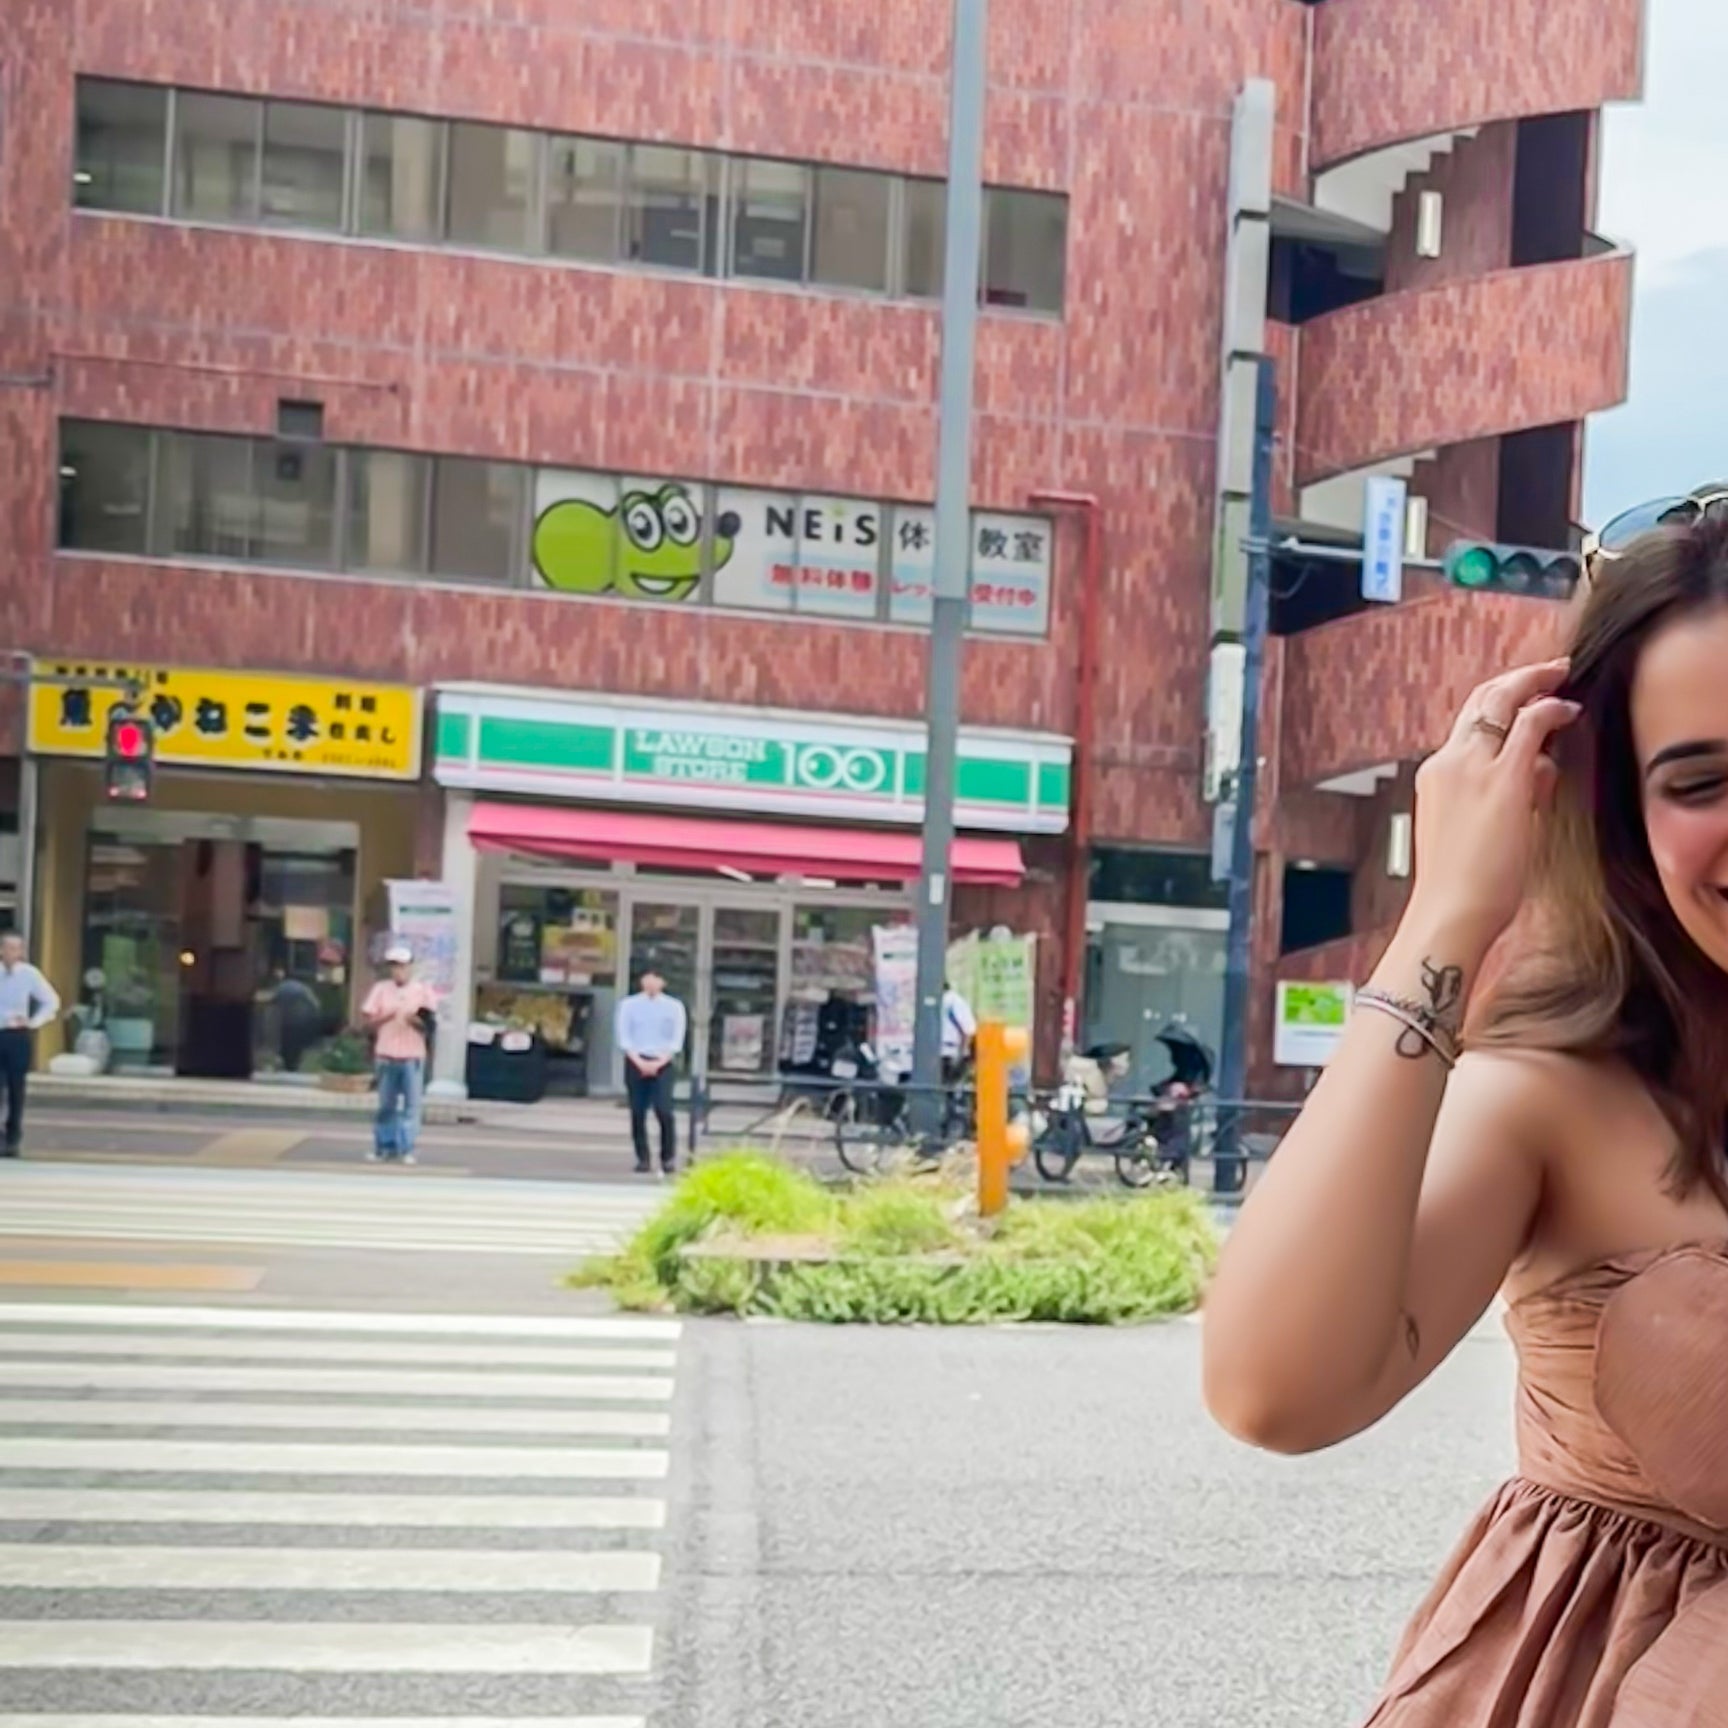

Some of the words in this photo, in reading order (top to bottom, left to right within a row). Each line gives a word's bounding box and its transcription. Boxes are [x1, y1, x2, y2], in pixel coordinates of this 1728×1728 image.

[766, 505, 877, 546] NEiS
[635, 730, 767, 762] LAWSON
[652, 755, 749, 782] STORE
[779, 741, 886, 793] 100
